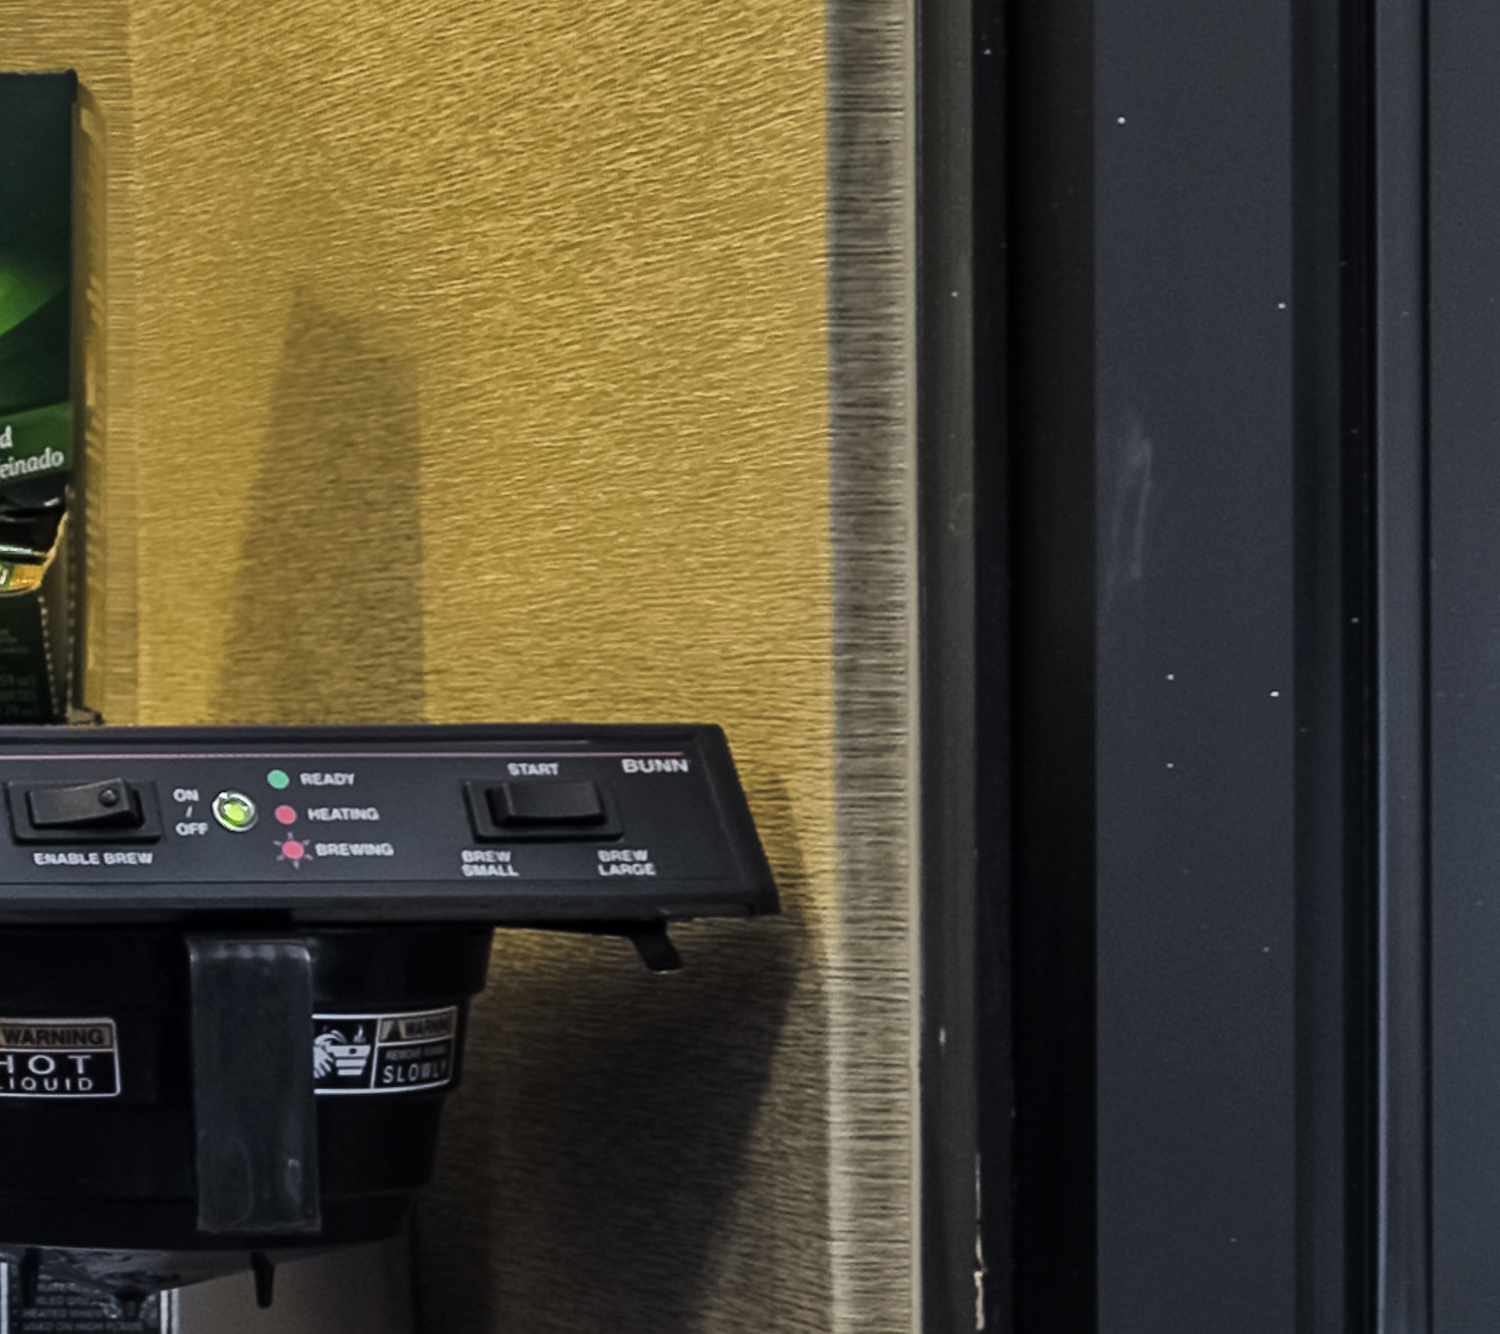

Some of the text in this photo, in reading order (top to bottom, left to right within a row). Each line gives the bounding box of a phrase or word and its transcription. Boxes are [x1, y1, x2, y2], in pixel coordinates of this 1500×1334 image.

[507, 762, 560, 776] START
[621, 758, 690, 773] BUNN
[300, 772, 356, 786] READY
[173, 788, 200, 803] ON
[307, 807, 380, 821] HEATING
[175, 822, 209, 837] OFF
[315, 842, 394, 857] BREWING
[461, 850, 511, 863] BREW
[597, 849, 649, 862] BREW
[33, 852, 154, 866] ENABLE BREW
[461, 863, 520, 877] SMALL
[598, 863, 657, 876] LARGE
[2, 1028, 105, 1046] WARNING
